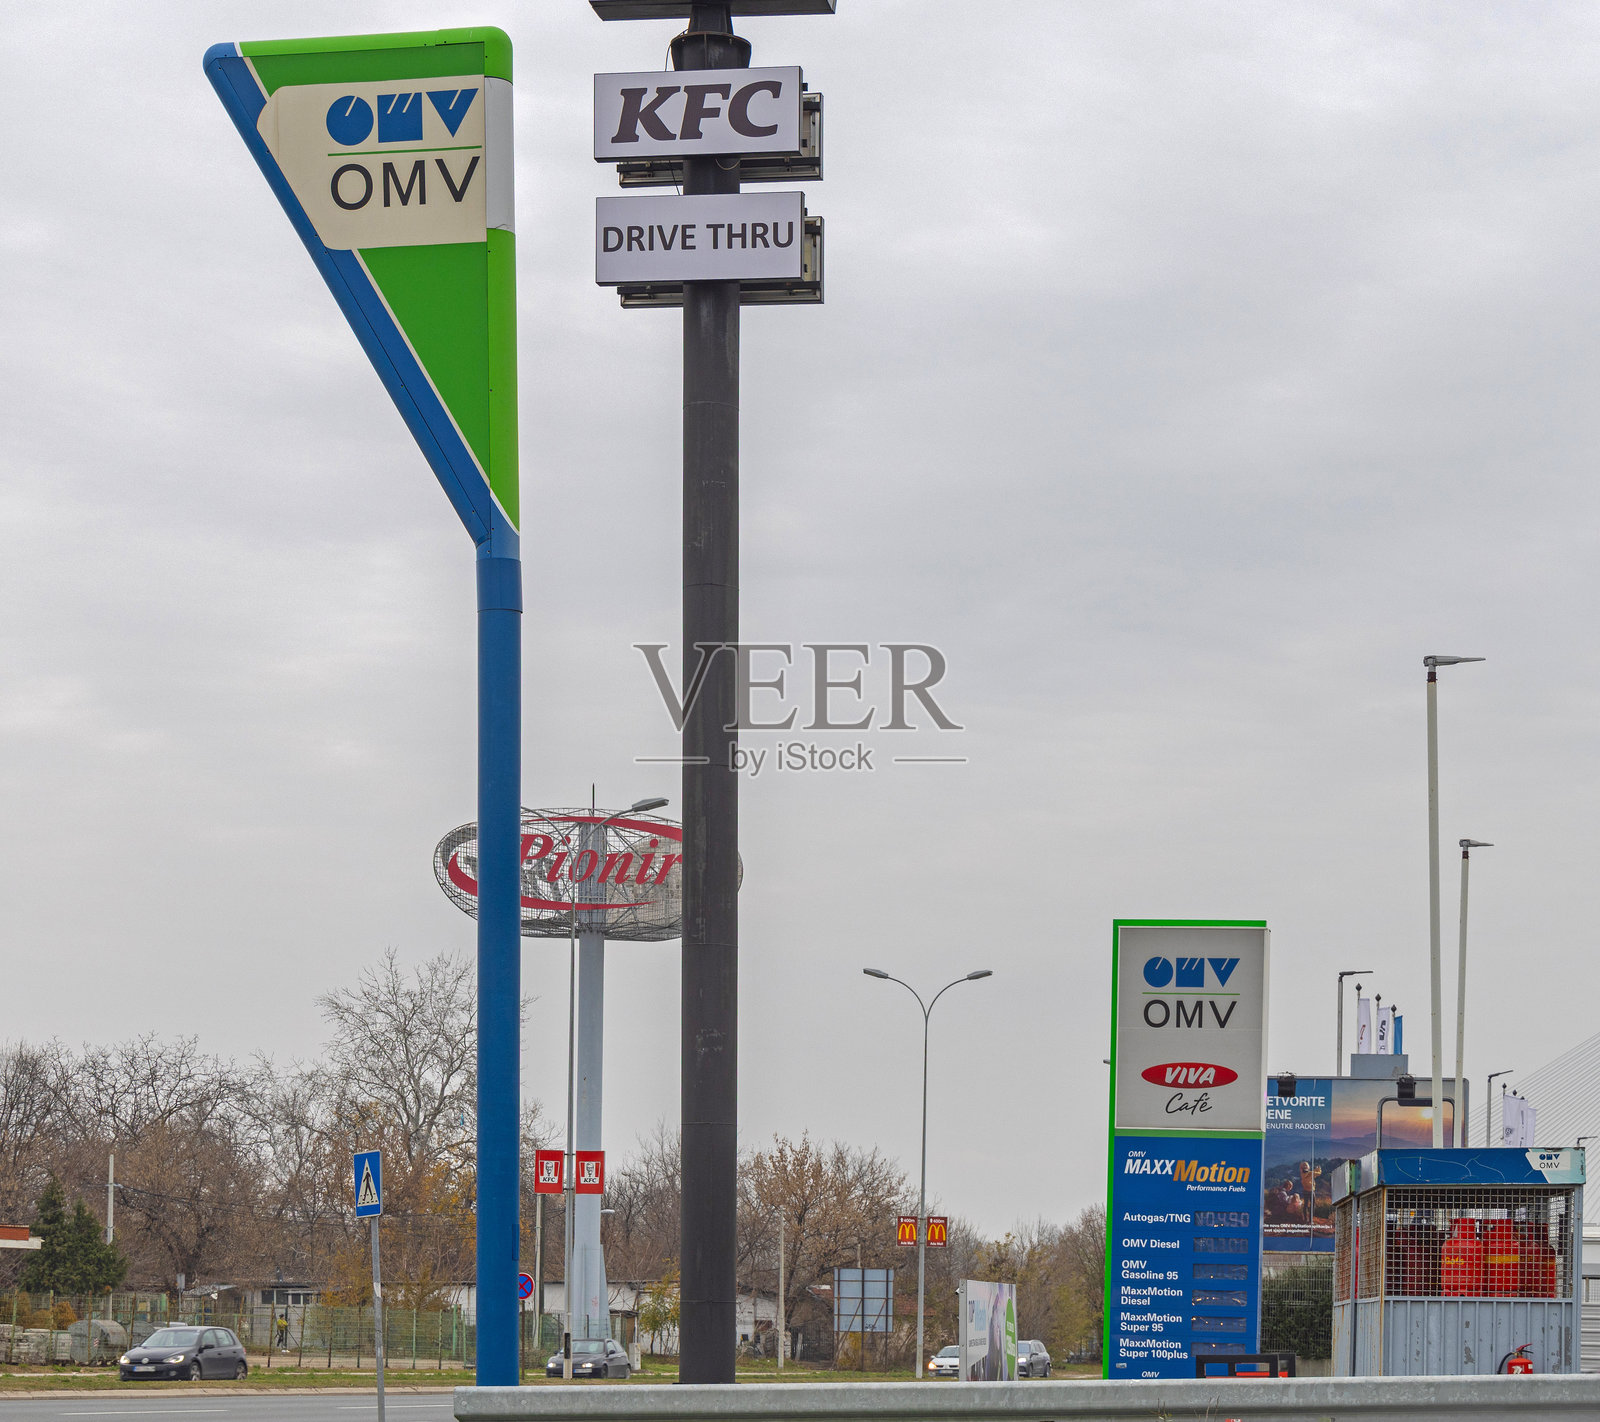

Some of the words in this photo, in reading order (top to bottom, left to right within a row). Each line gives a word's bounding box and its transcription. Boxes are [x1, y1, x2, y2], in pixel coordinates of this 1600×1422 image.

[326, 88, 479, 146] OMV
[611, 80, 783, 144] KFC
[330, 156, 480, 211] OMV
[602, 223, 697, 253] DRIVE
[713, 221, 795, 250] THRU
[520, 833, 682, 885] Pionir
[1143, 956, 1240, 988] OMV
[1143, 999, 1237, 1029] OMV
[1164, 1066, 1216, 1085] VIVA
[1165, 1092, 1213, 1115] Café
[1267, 1096, 1325, 1107] ETVORITE
[1266, 1109, 1292, 1120] ENE
[1266, 1122, 1293, 1130] ENUTKE
[1186, 1184, 1228, 1192] Performance
[1123, 1212, 1191, 1224] Autogas/TNG
[1122, 1238, 1147, 1248] OMV
[1150, 1239, 1180, 1249] Diesel
[1121, 1260, 1147, 1269] OMV
[1121, 1270, 1165, 1280] Gasoline
[1166, 1271, 1179, 1280] 95
[1121, 1286, 1183, 1297] MaxxMotion
[1121, 1296, 1151, 1305] Diesel
[1120, 1312, 1182, 1323] MaxxMotion
[1120, 1322, 1150, 1333] Super
[1151, 1323, 1164, 1332] 95
[1119, 1338, 1182, 1349] MaxxMotion
[1119, 1348, 1149, 1359] Super
[1151, 1349, 1189, 1360] 100plus
